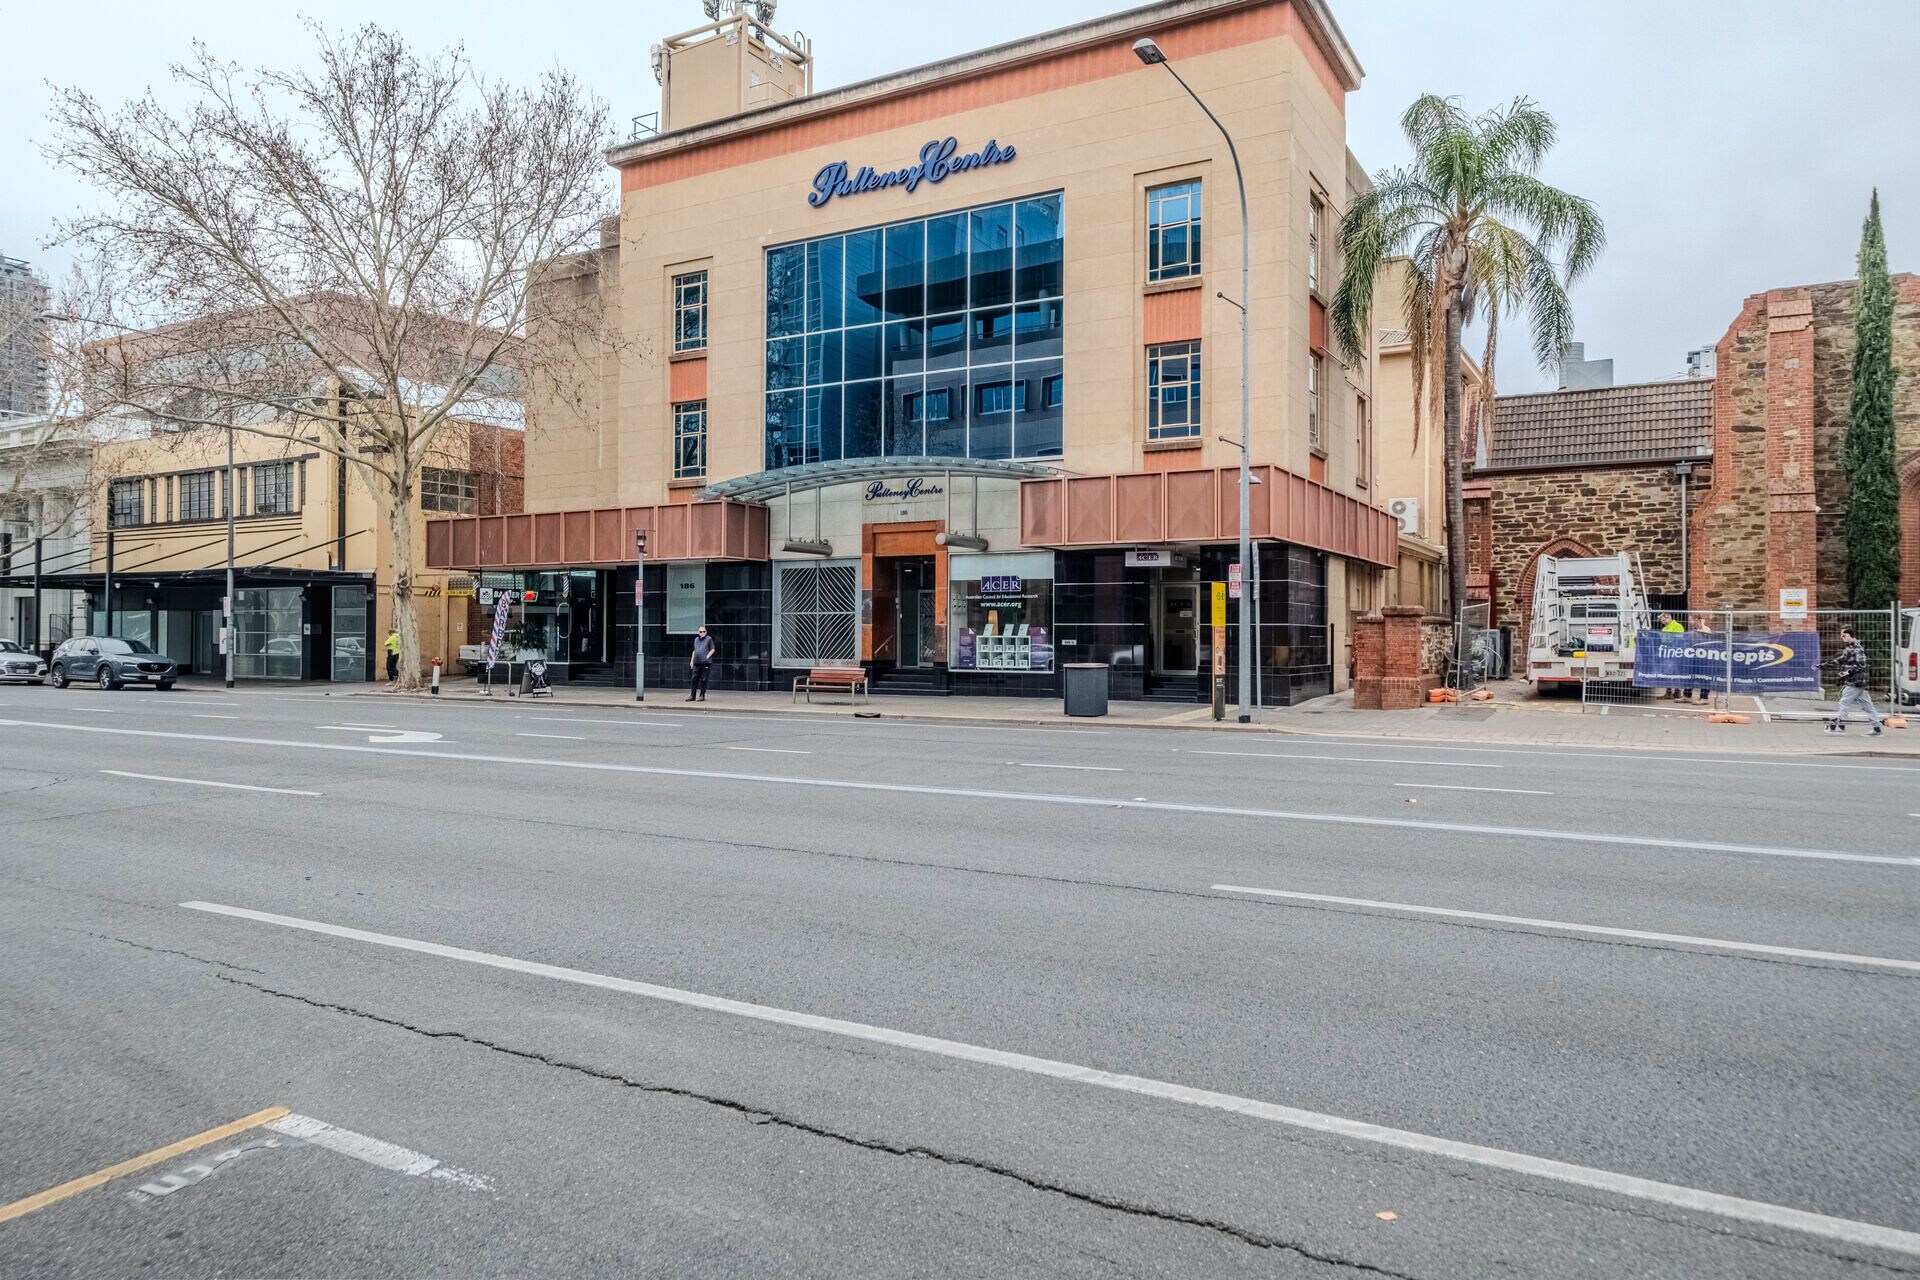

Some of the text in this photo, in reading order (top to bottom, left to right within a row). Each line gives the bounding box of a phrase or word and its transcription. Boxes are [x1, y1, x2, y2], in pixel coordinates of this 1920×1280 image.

[807, 136, 1017, 208] Pulteney Centre
[865, 478, 944, 501] Pulteney Centre
[1137, 553, 1159, 561] ACER
[981, 578, 1021, 592] ACER
[980, 601, 1022, 609] www.acer.org
[1658, 644, 1776, 665] fineconcepts
